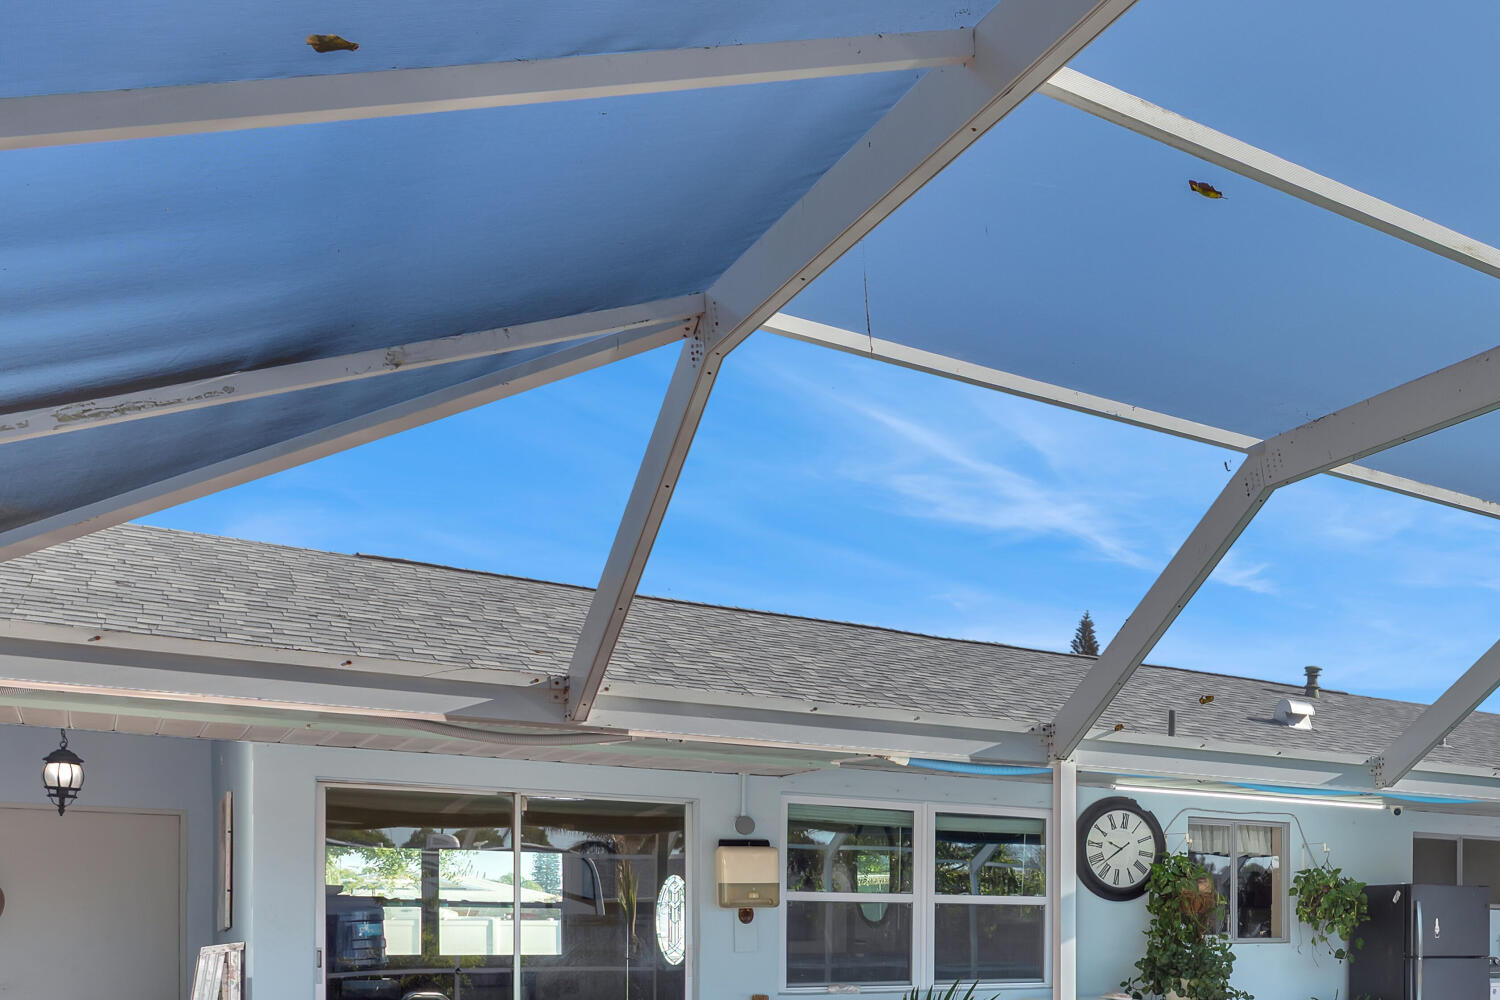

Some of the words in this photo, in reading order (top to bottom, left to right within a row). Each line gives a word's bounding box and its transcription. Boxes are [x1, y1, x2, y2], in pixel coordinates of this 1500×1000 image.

[1107, 813, 1117, 830] XI
[1120, 812, 1130, 829] XII
[1132, 820, 1142, 834] I
[1094, 823, 1108, 837] X
[1088, 840, 1103, 848] IX
[1137, 835, 1152, 844] II
[1139, 850, 1153, 858] III
[1113, 868, 1120, 885] VI
[1127, 867, 1135, 884] V
